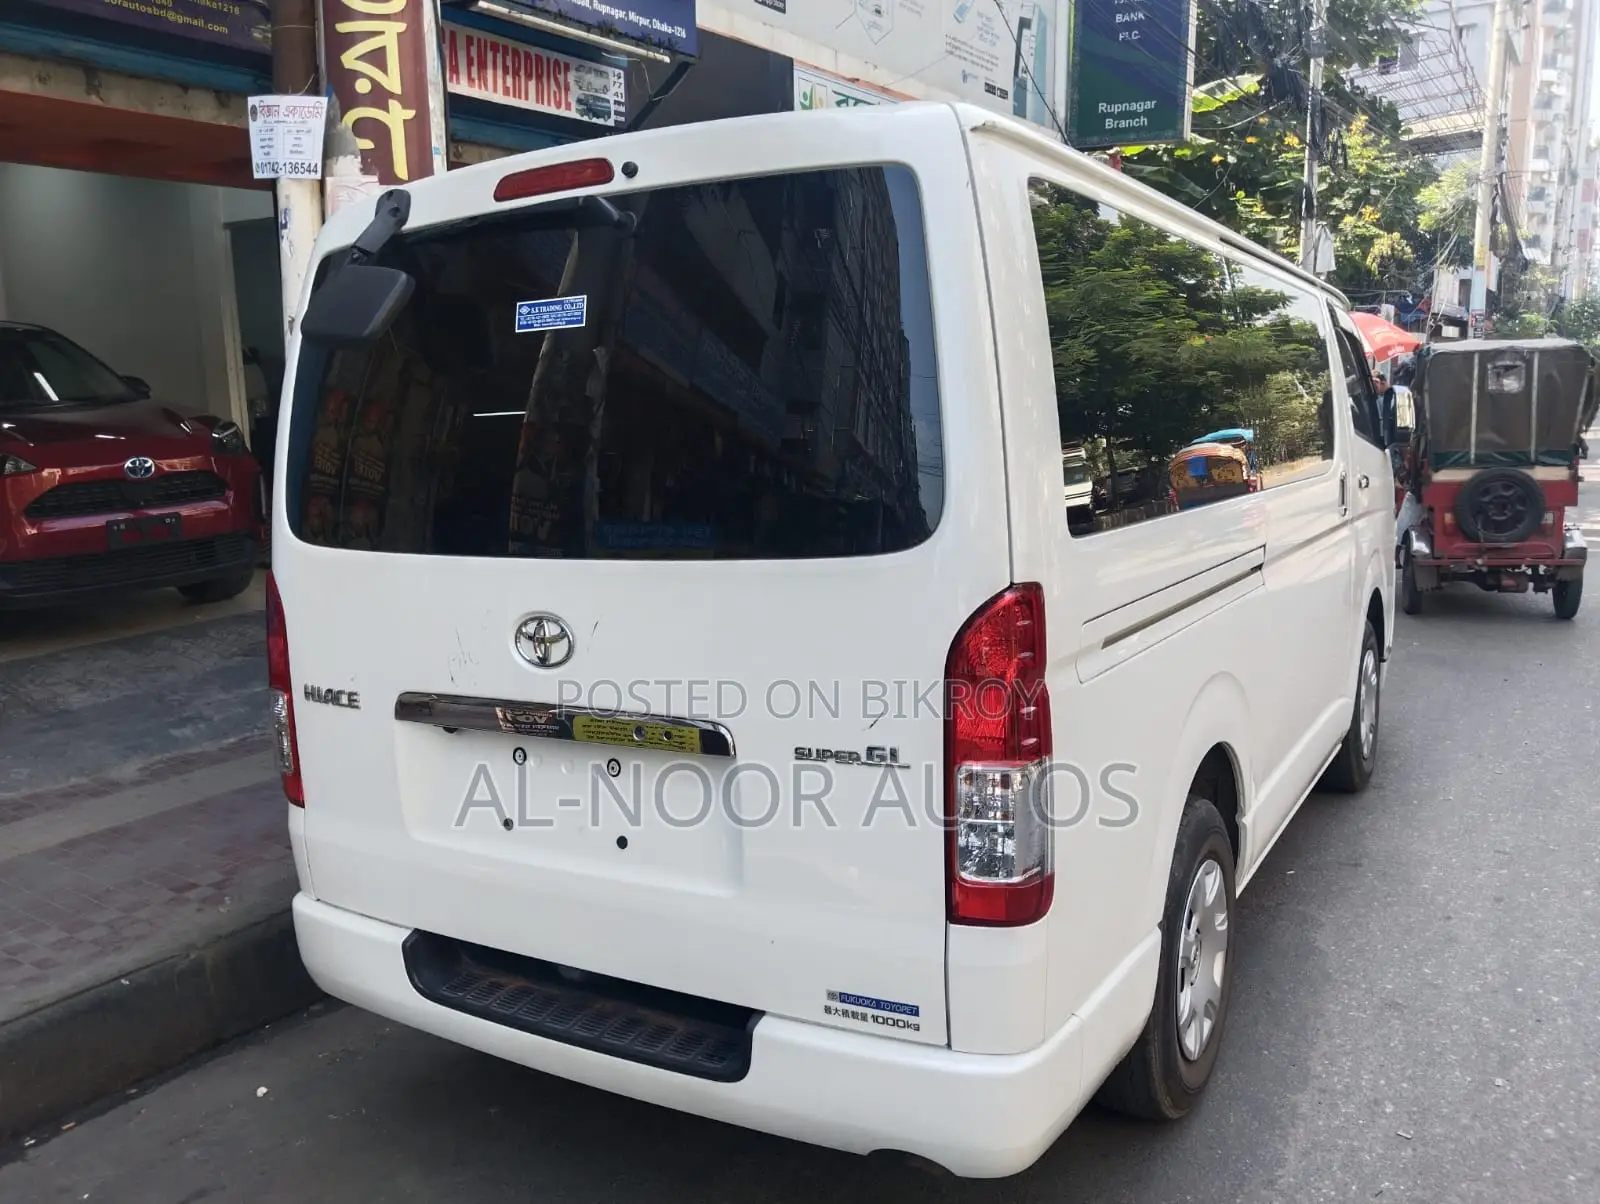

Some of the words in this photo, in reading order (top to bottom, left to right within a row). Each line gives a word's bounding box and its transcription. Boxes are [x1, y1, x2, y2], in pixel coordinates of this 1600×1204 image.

[628, 10, 652, 29] Mirpur,
[1115, 11, 1145, 23] BANK
[465, 35, 572, 112] ENTERPRISE
[1098, 100, 1157, 115] Rupnagar
[1105, 115, 1148, 129] Branch
[794, 746, 861, 764] SUPER
[840, 993, 877, 1008] FUKUOKA
[880, 1001, 918, 1015] TOYOPET
[870, 1013, 920, 1032] 1000kg
